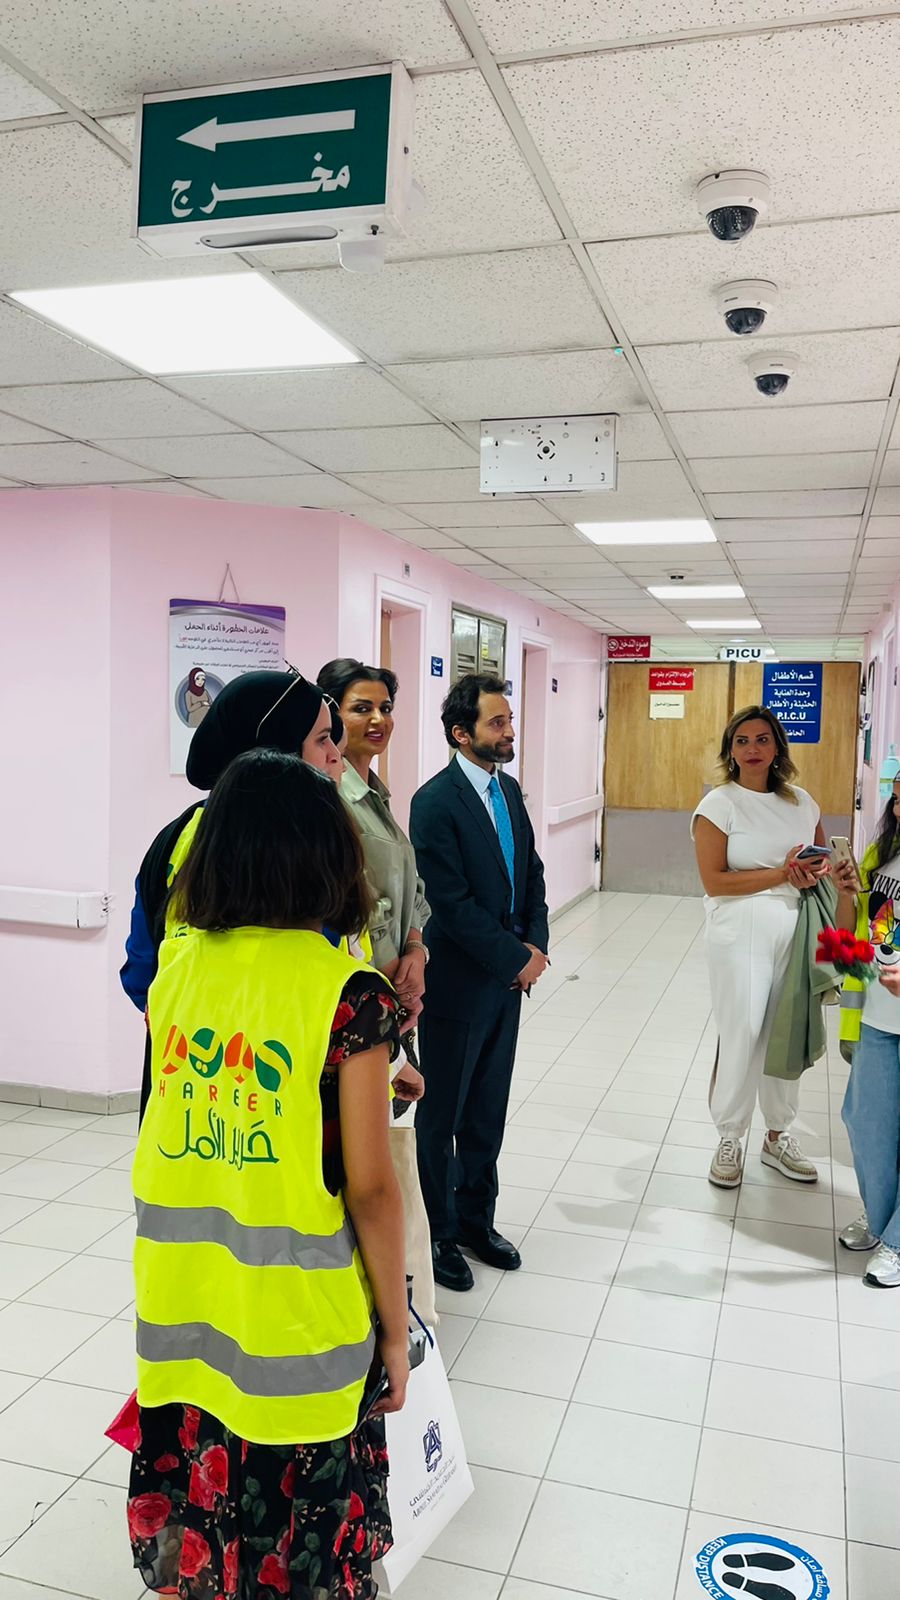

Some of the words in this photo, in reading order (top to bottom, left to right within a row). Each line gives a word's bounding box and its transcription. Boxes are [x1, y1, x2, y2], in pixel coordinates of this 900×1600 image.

[171, 152, 350, 218] مخرج
[726, 648, 761, 658] PICU
[771, 669, 798, 682] الأطفال
[798, 670, 814, 682] قسم
[774, 688, 794, 698] العناية
[794, 689, 811, 698] وحدة
[776, 712, 807, 720] P.I.C.U
[159, 1079, 282, 1117] HAREER
[157, 1107, 226, 1161] الأمل
[704, 1537, 728, 1556] KEEP
[698, 1554, 725, 1599] DISTANCE
